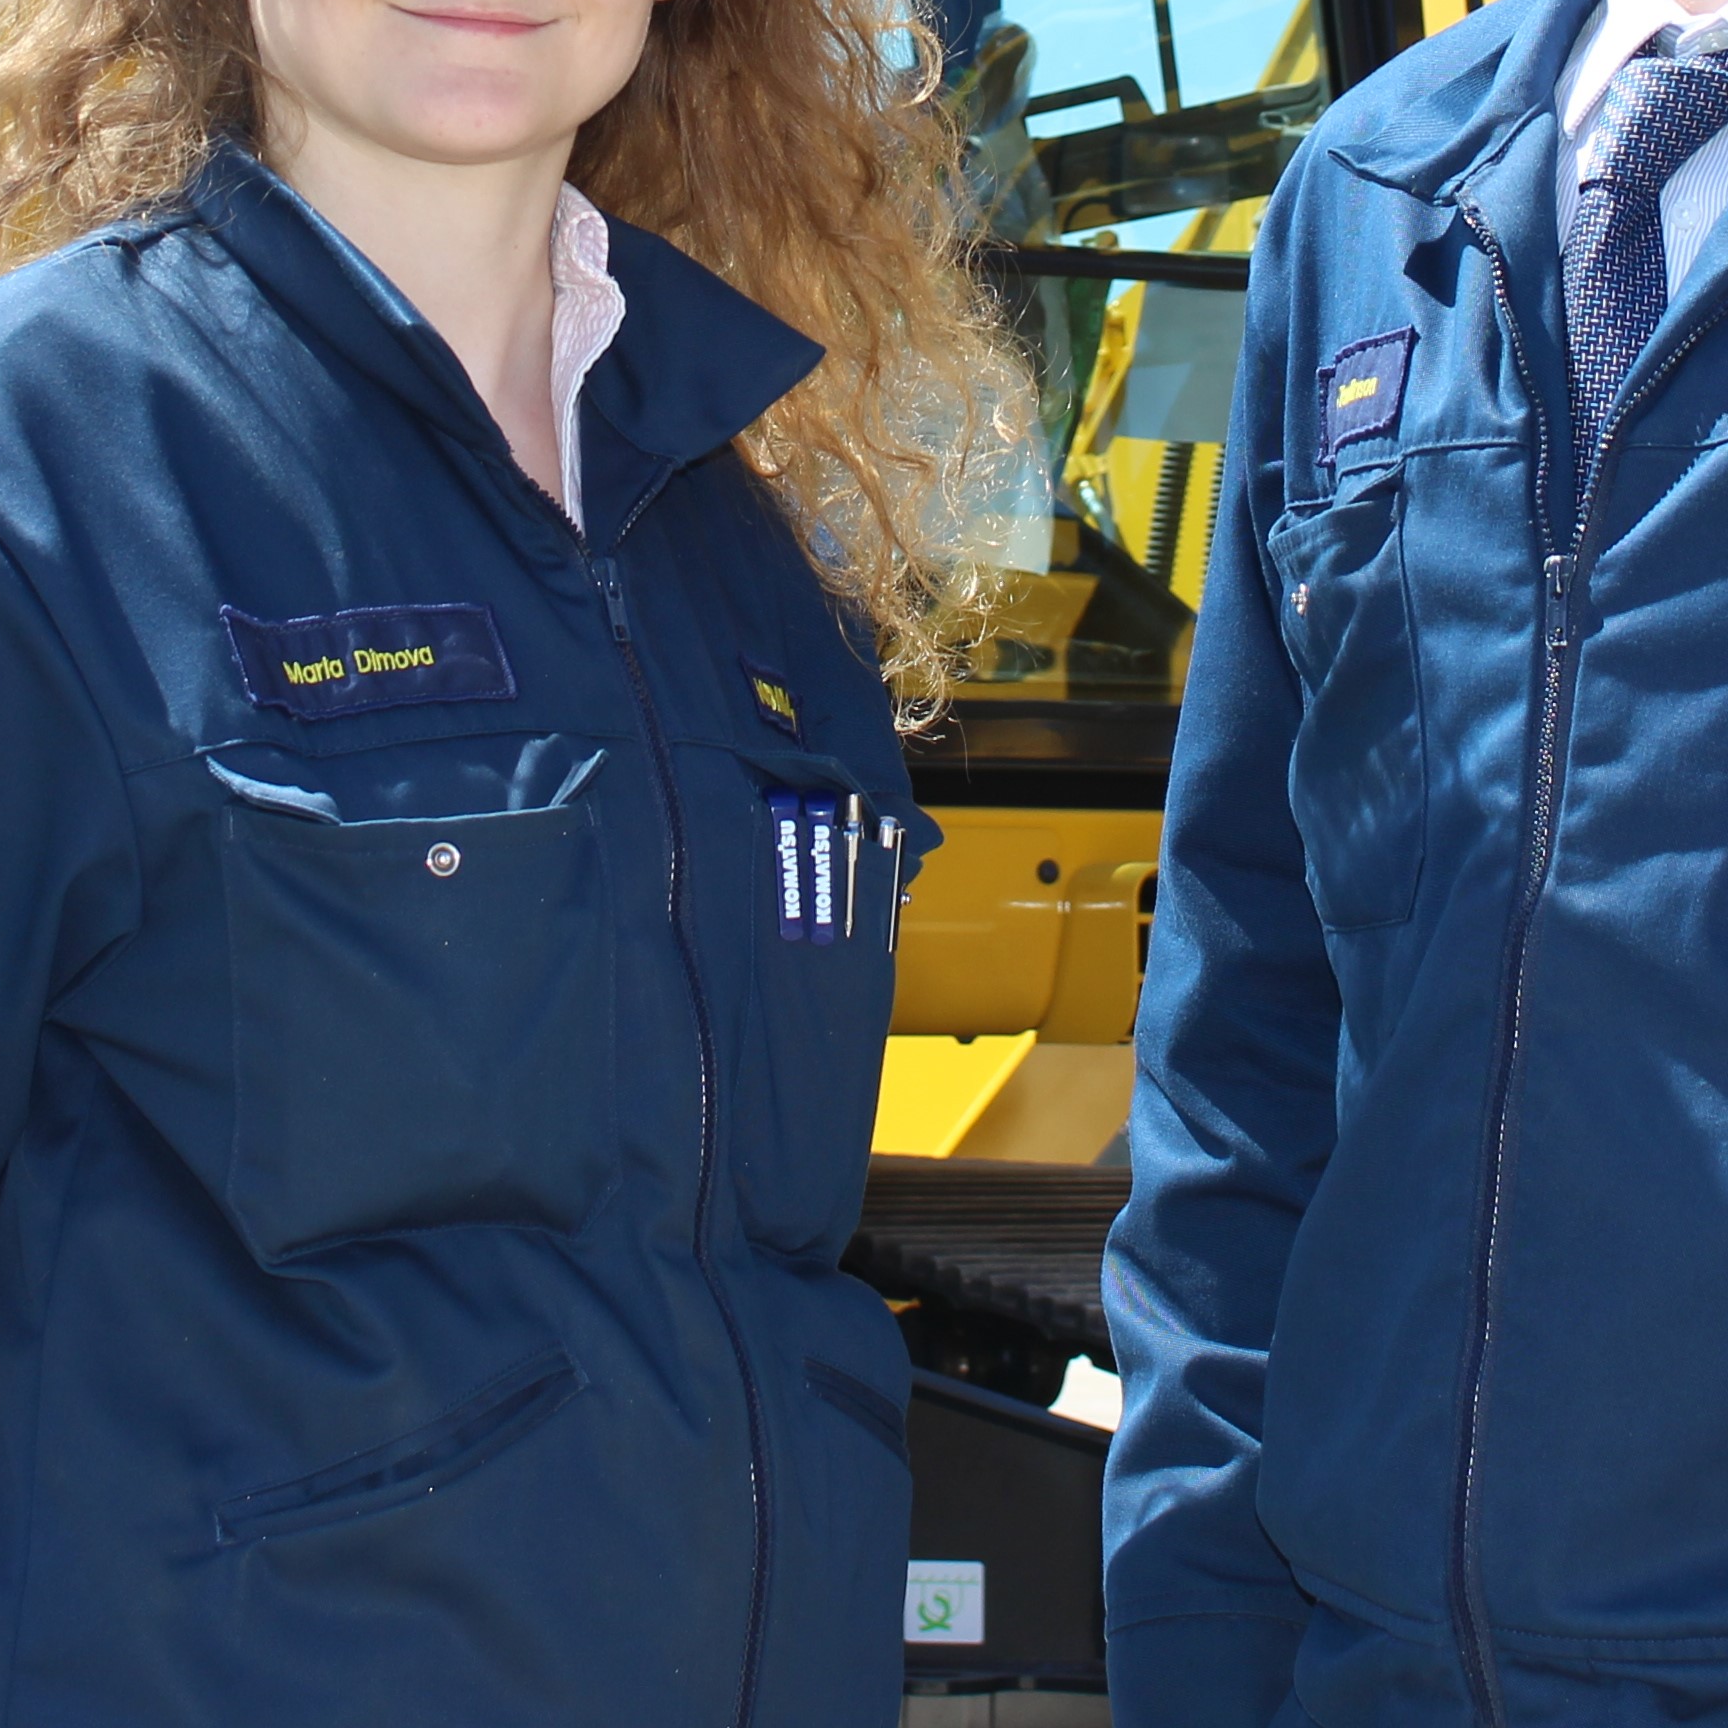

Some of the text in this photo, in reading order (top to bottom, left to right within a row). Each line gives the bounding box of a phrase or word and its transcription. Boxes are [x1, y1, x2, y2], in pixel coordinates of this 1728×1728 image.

[353, 645, 434, 673] Dimova
[777, 819, 801, 919] KOMATSU
[810, 824, 832, 924] KOMATSU
